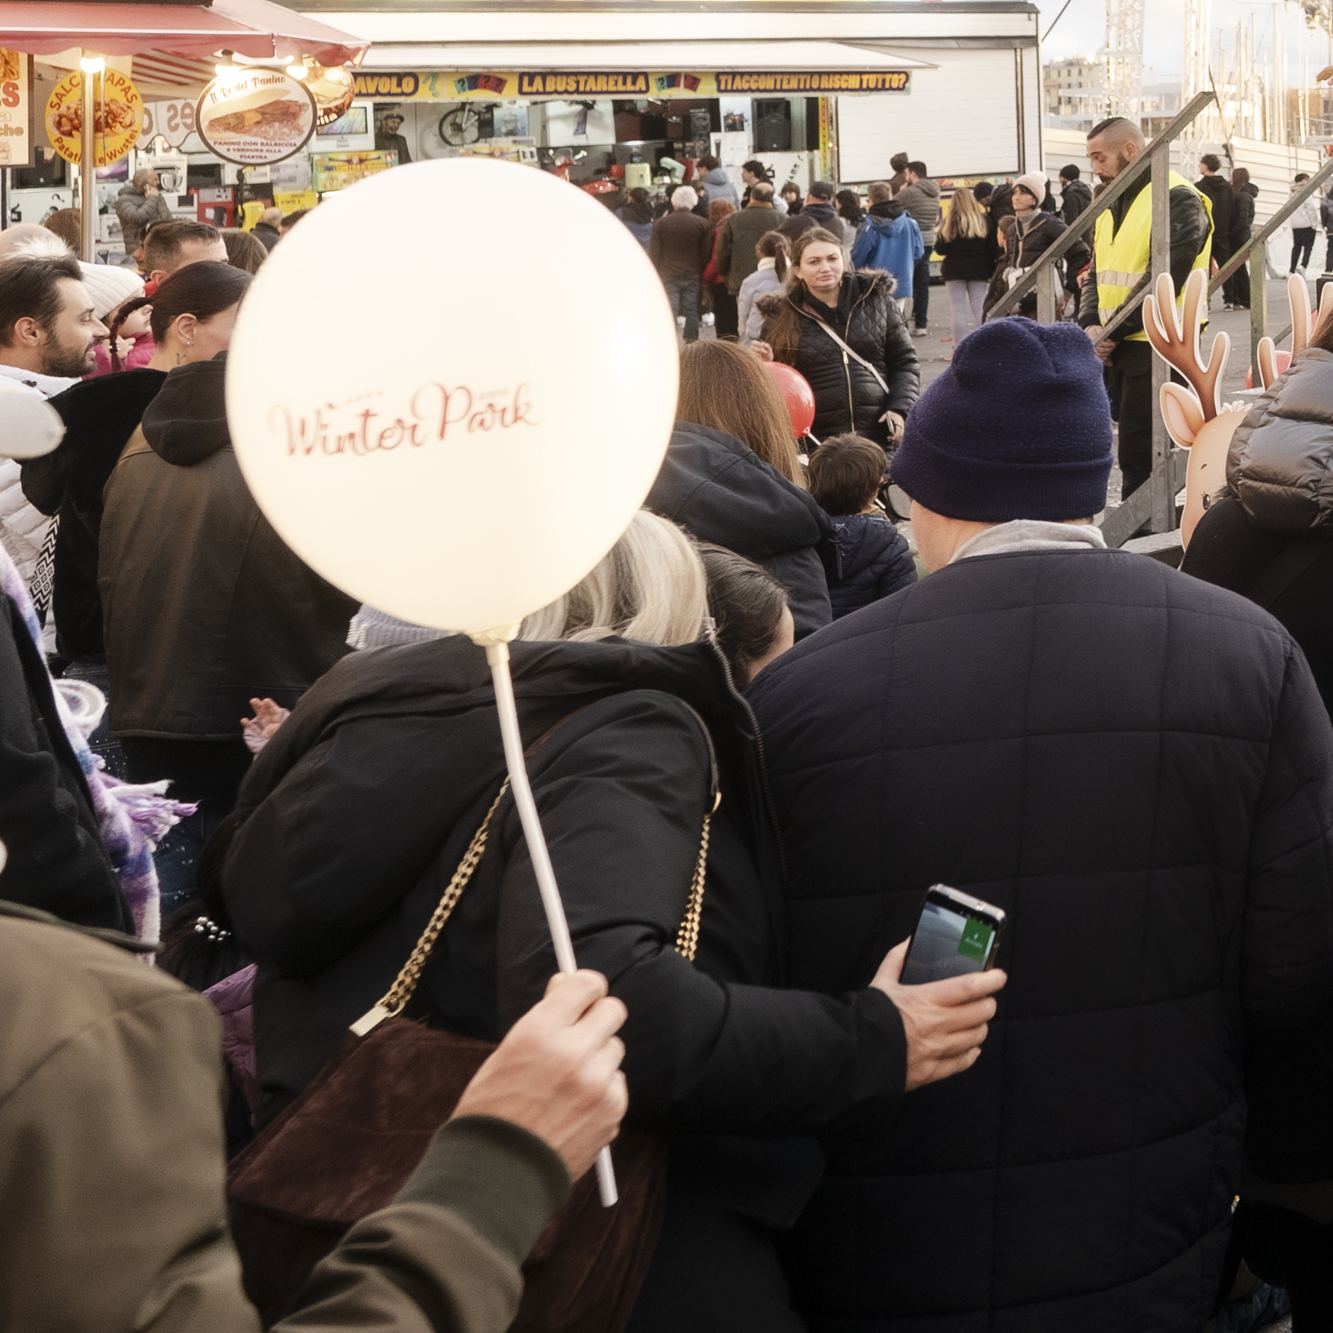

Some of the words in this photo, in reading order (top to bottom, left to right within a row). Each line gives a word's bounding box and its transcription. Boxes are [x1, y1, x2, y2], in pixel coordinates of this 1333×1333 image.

[252, 75, 286, 88] Panino
[355, 74, 414, 95] AVOLO
[522, 75, 543, 93] LA
[545, 74, 647, 93] BUSTARELLA
[861, 73, 907, 89] TUTTO?
[266, 403, 428, 456] Winter
[410, 381, 540, 440] Park
